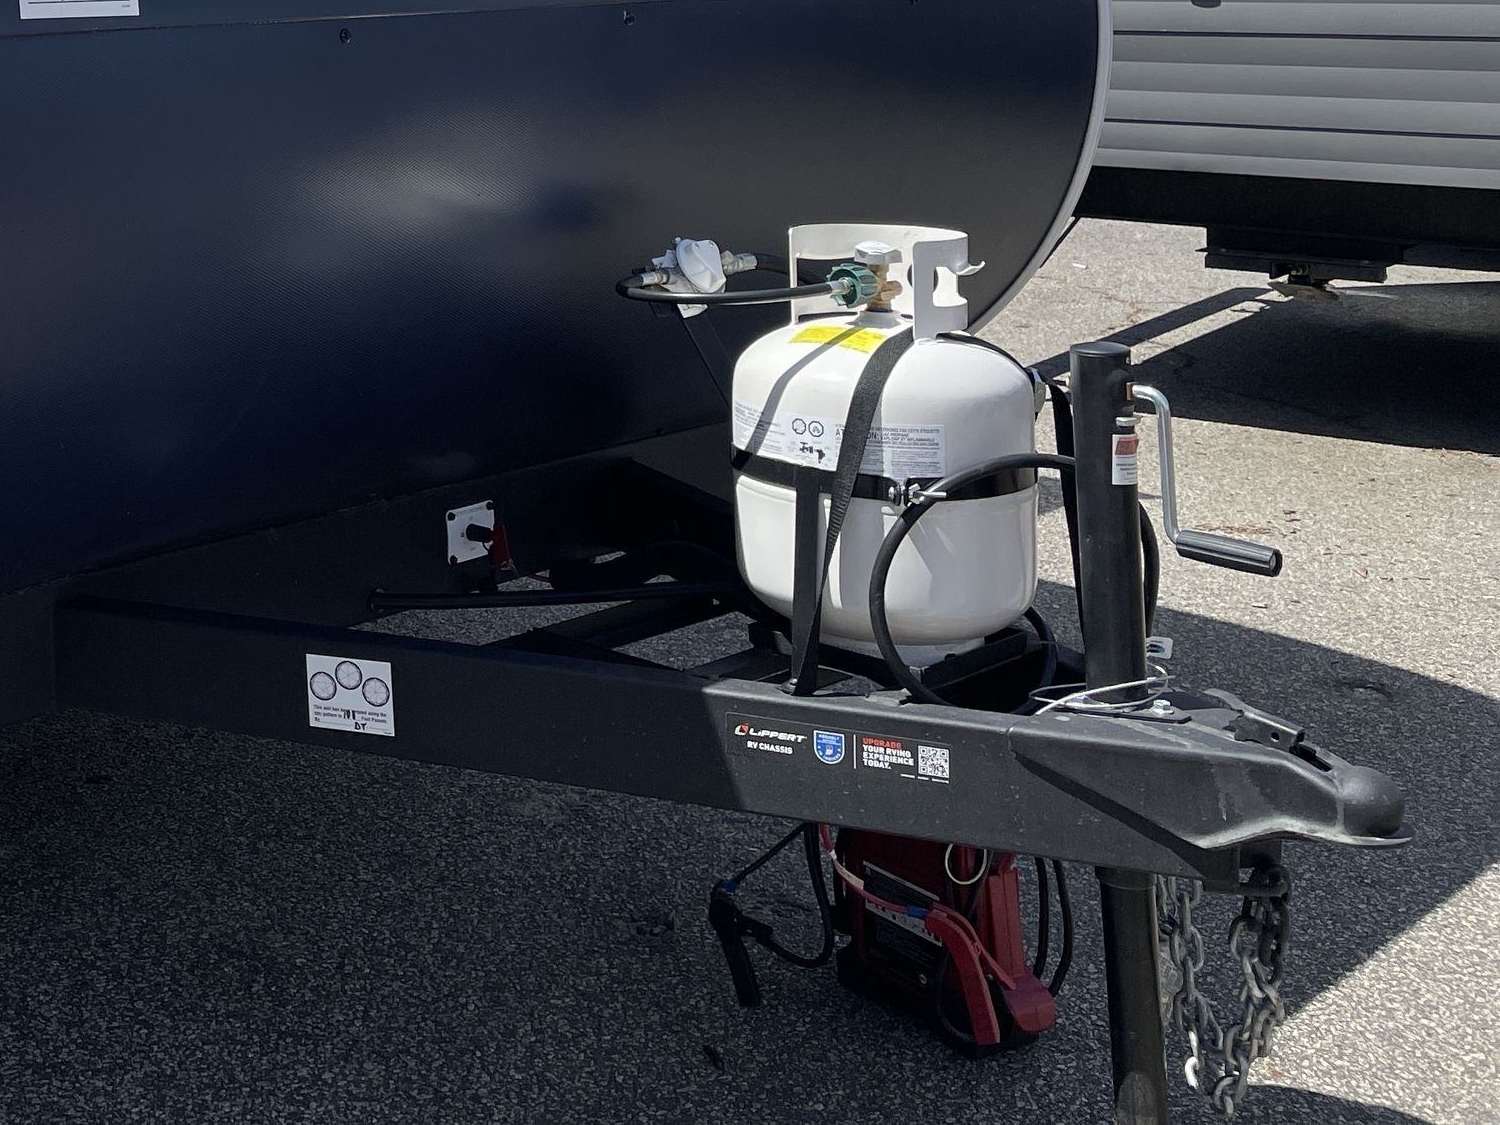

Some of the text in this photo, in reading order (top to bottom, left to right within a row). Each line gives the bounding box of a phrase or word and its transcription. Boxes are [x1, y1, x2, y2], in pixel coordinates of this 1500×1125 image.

[746, 740, 793, 755] RV CHASSIS
[862, 737, 902, 749] UPGRADE
[862, 744, 885, 754] YOUR
[862, 751, 914, 766] EXPERIENCE
[862, 758, 892, 770] TODAY.
